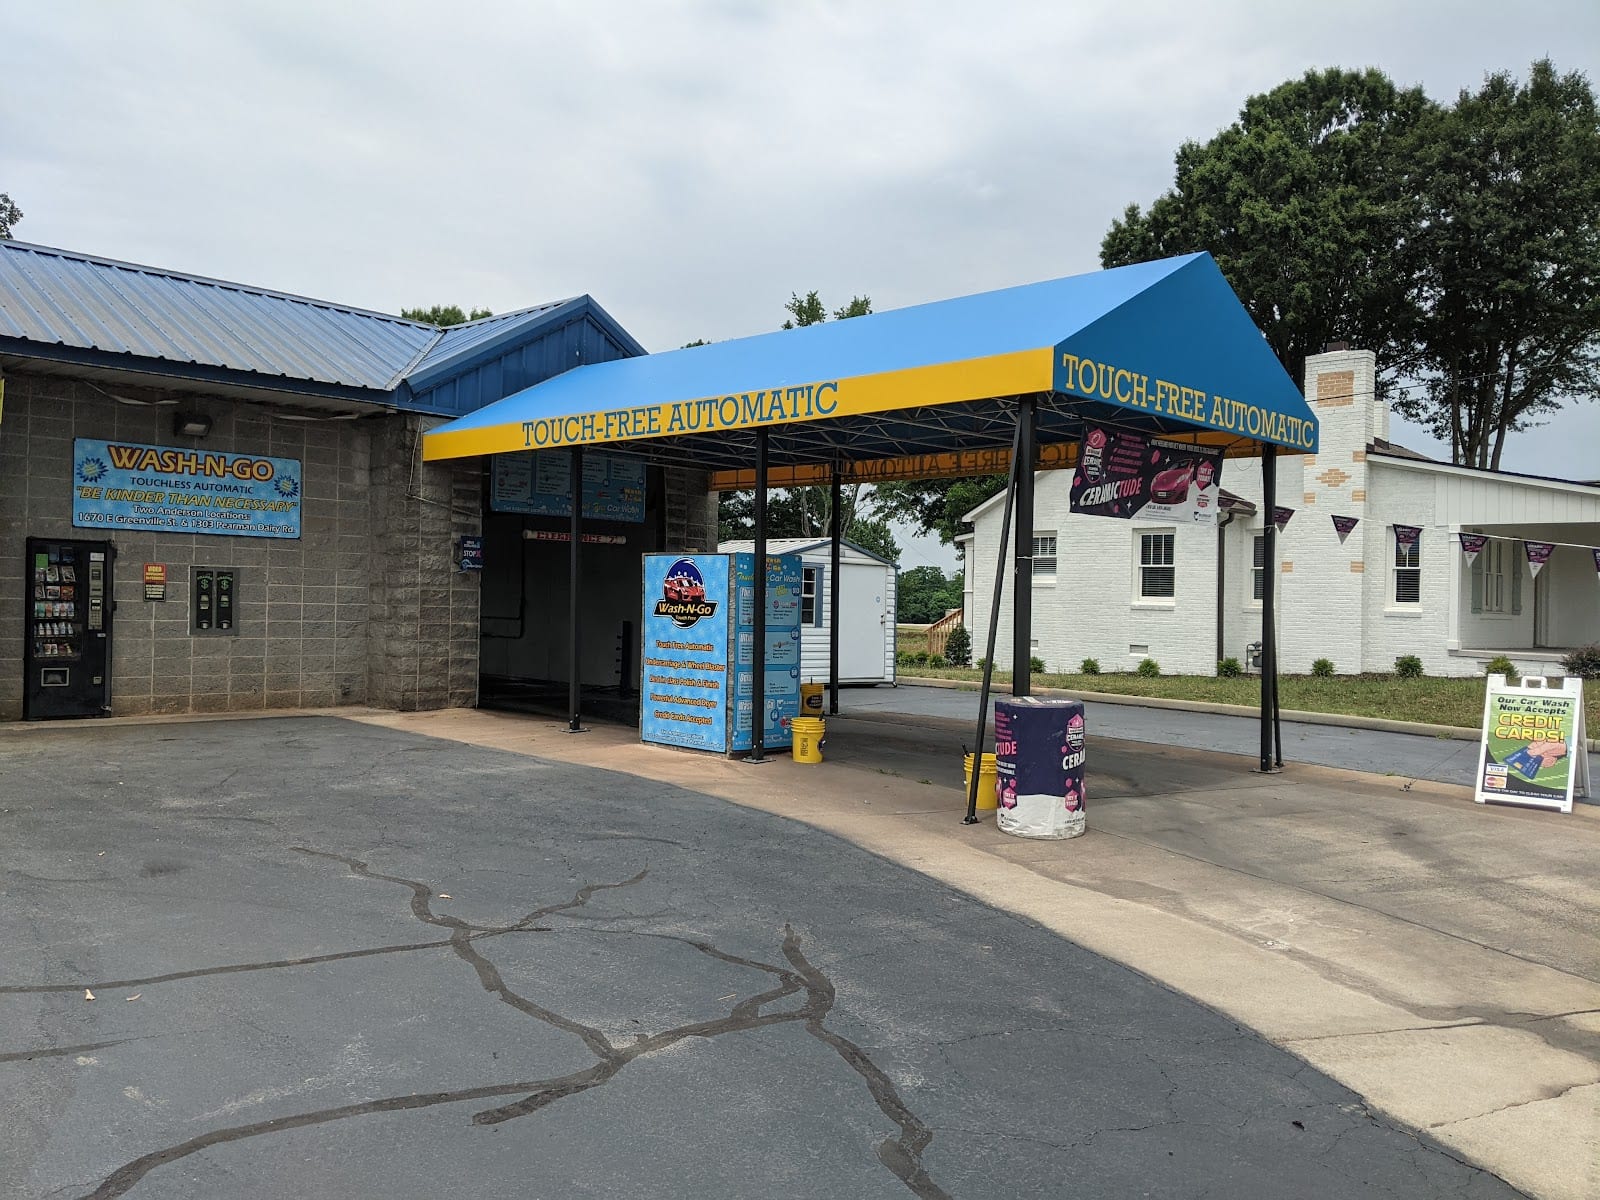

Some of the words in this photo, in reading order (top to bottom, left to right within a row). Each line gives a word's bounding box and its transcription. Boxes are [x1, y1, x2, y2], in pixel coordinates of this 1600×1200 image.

[1062, 353, 1206, 422] TOUCH-FREE
[1210, 396, 1314, 448] AUTOMATIC
[522, 406, 661, 447] TOUCH-FREE
[667, 382, 838, 431] AUTOMATIC
[107, 445, 274, 482] WASH-N-GO
[130, 477, 192, 490] TOUCHLESS
[193, 481, 254, 494] AUTOMATIC
[1079, 476, 1143, 507] CERAMICTUDE
[105, 488, 165, 504] KINDER
[169, 493, 212, 508] THAN
[133, 505, 155, 514] Two
[156, 507, 203, 517] Anderson
[205, 510, 251, 521] Locations:
[79, 512, 104, 522] 1670
[115, 515, 166, 525] Greenville
[167, 518, 179, 527] St.
[180, 519, 188, 527] &
[191, 520, 214, 529] 1303
[216, 521, 256, 532] Pearman
[257, 524, 280, 535] Dairy
[537, 531, 602, 543] CLEARNCE
[769, 574, 783, 582] Car
[783, 574, 801, 583] Wash
[659, 602, 711, 614] Wash-N-Go
[684, 641, 714, 651] Automatic
[1497, 696, 1516, 704] Our
[1520, 698, 1537, 706] Car
[1542, 699, 1570, 708] Wash
[1499, 704, 1520, 712] Now
[1525, 705, 1566, 715] Accepts
[1498, 713, 1563, 729] CREDIT
[1495, 726, 1565, 743] CARDS!
